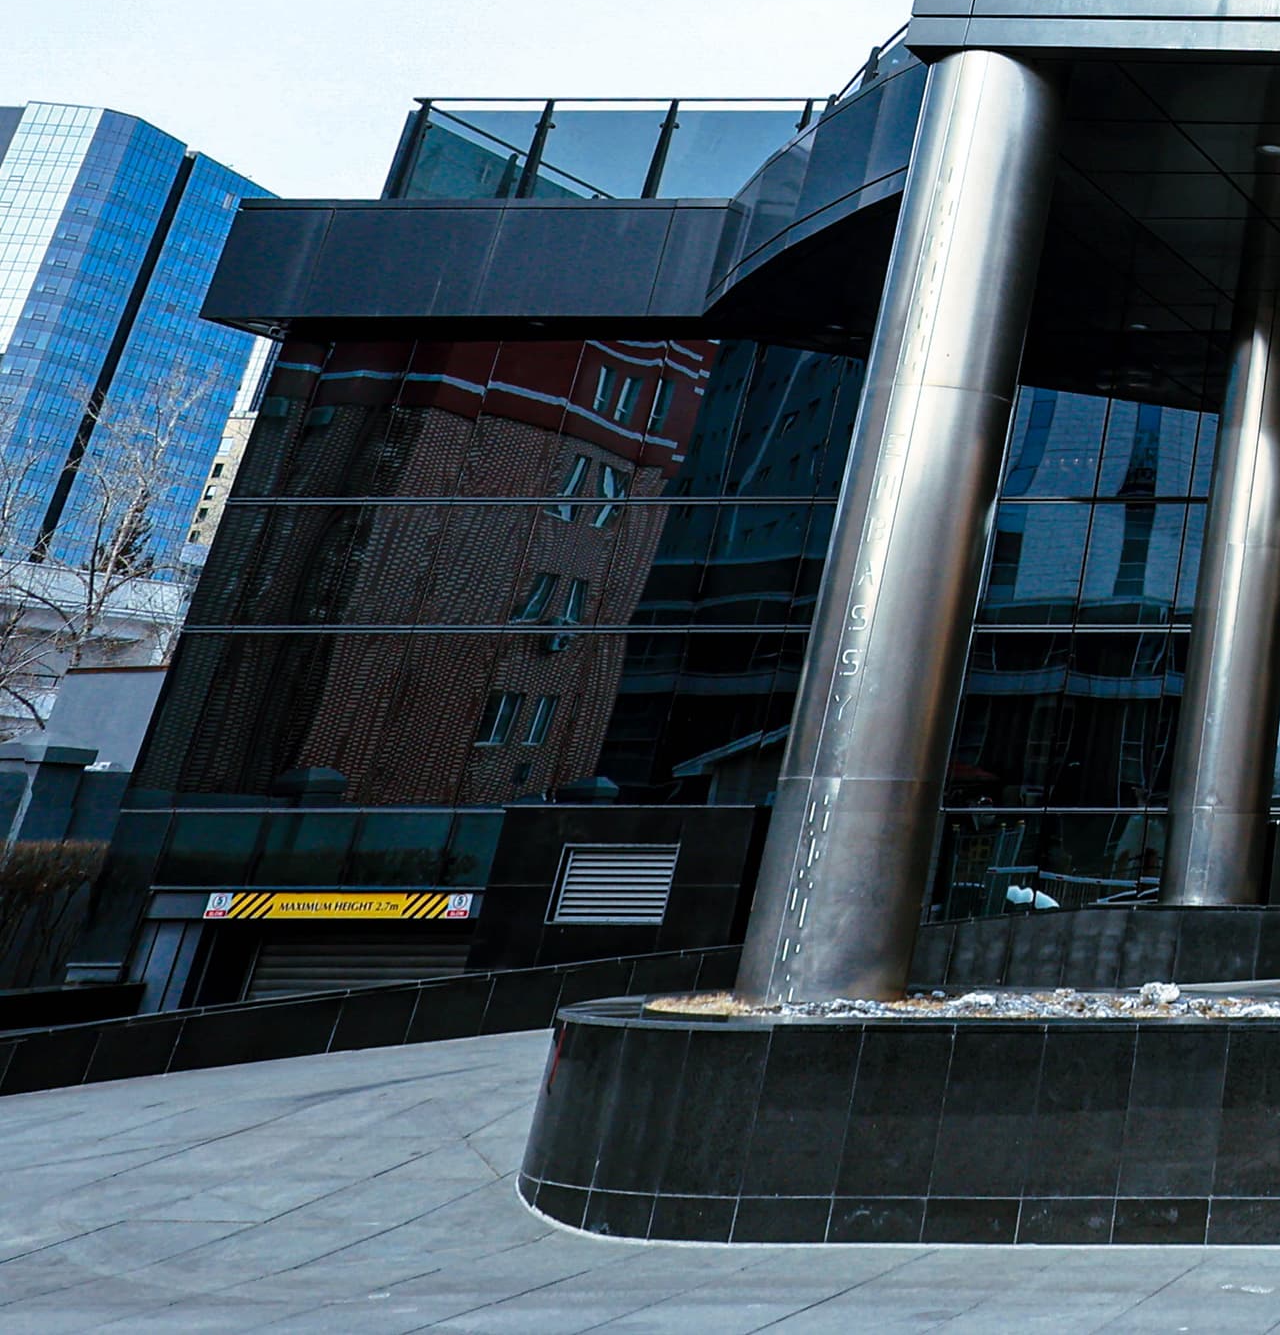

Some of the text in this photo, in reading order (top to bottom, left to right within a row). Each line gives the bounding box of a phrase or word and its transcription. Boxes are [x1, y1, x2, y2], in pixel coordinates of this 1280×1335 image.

[280, 901, 399, 912] MAXIMUM HEIGHT 2.7m
